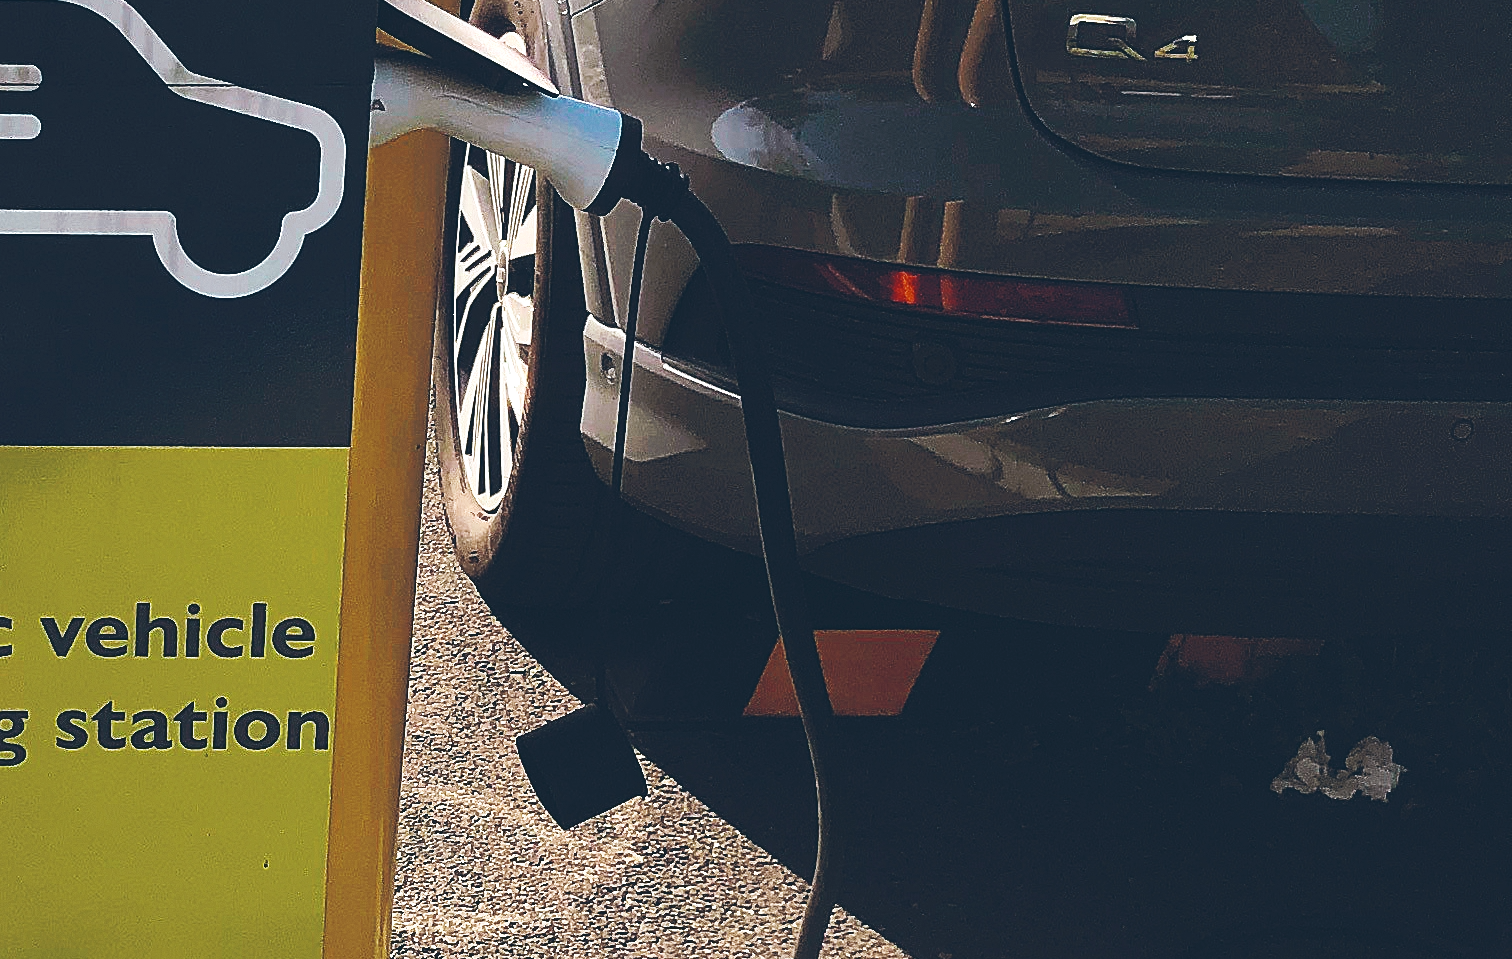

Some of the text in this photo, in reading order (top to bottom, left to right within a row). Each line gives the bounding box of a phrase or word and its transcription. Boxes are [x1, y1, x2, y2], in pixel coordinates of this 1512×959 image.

[1066, 13, 1198, 61] Q4
[39, 602, 316, 659] vehicle
[55, 696, 330, 751] station
